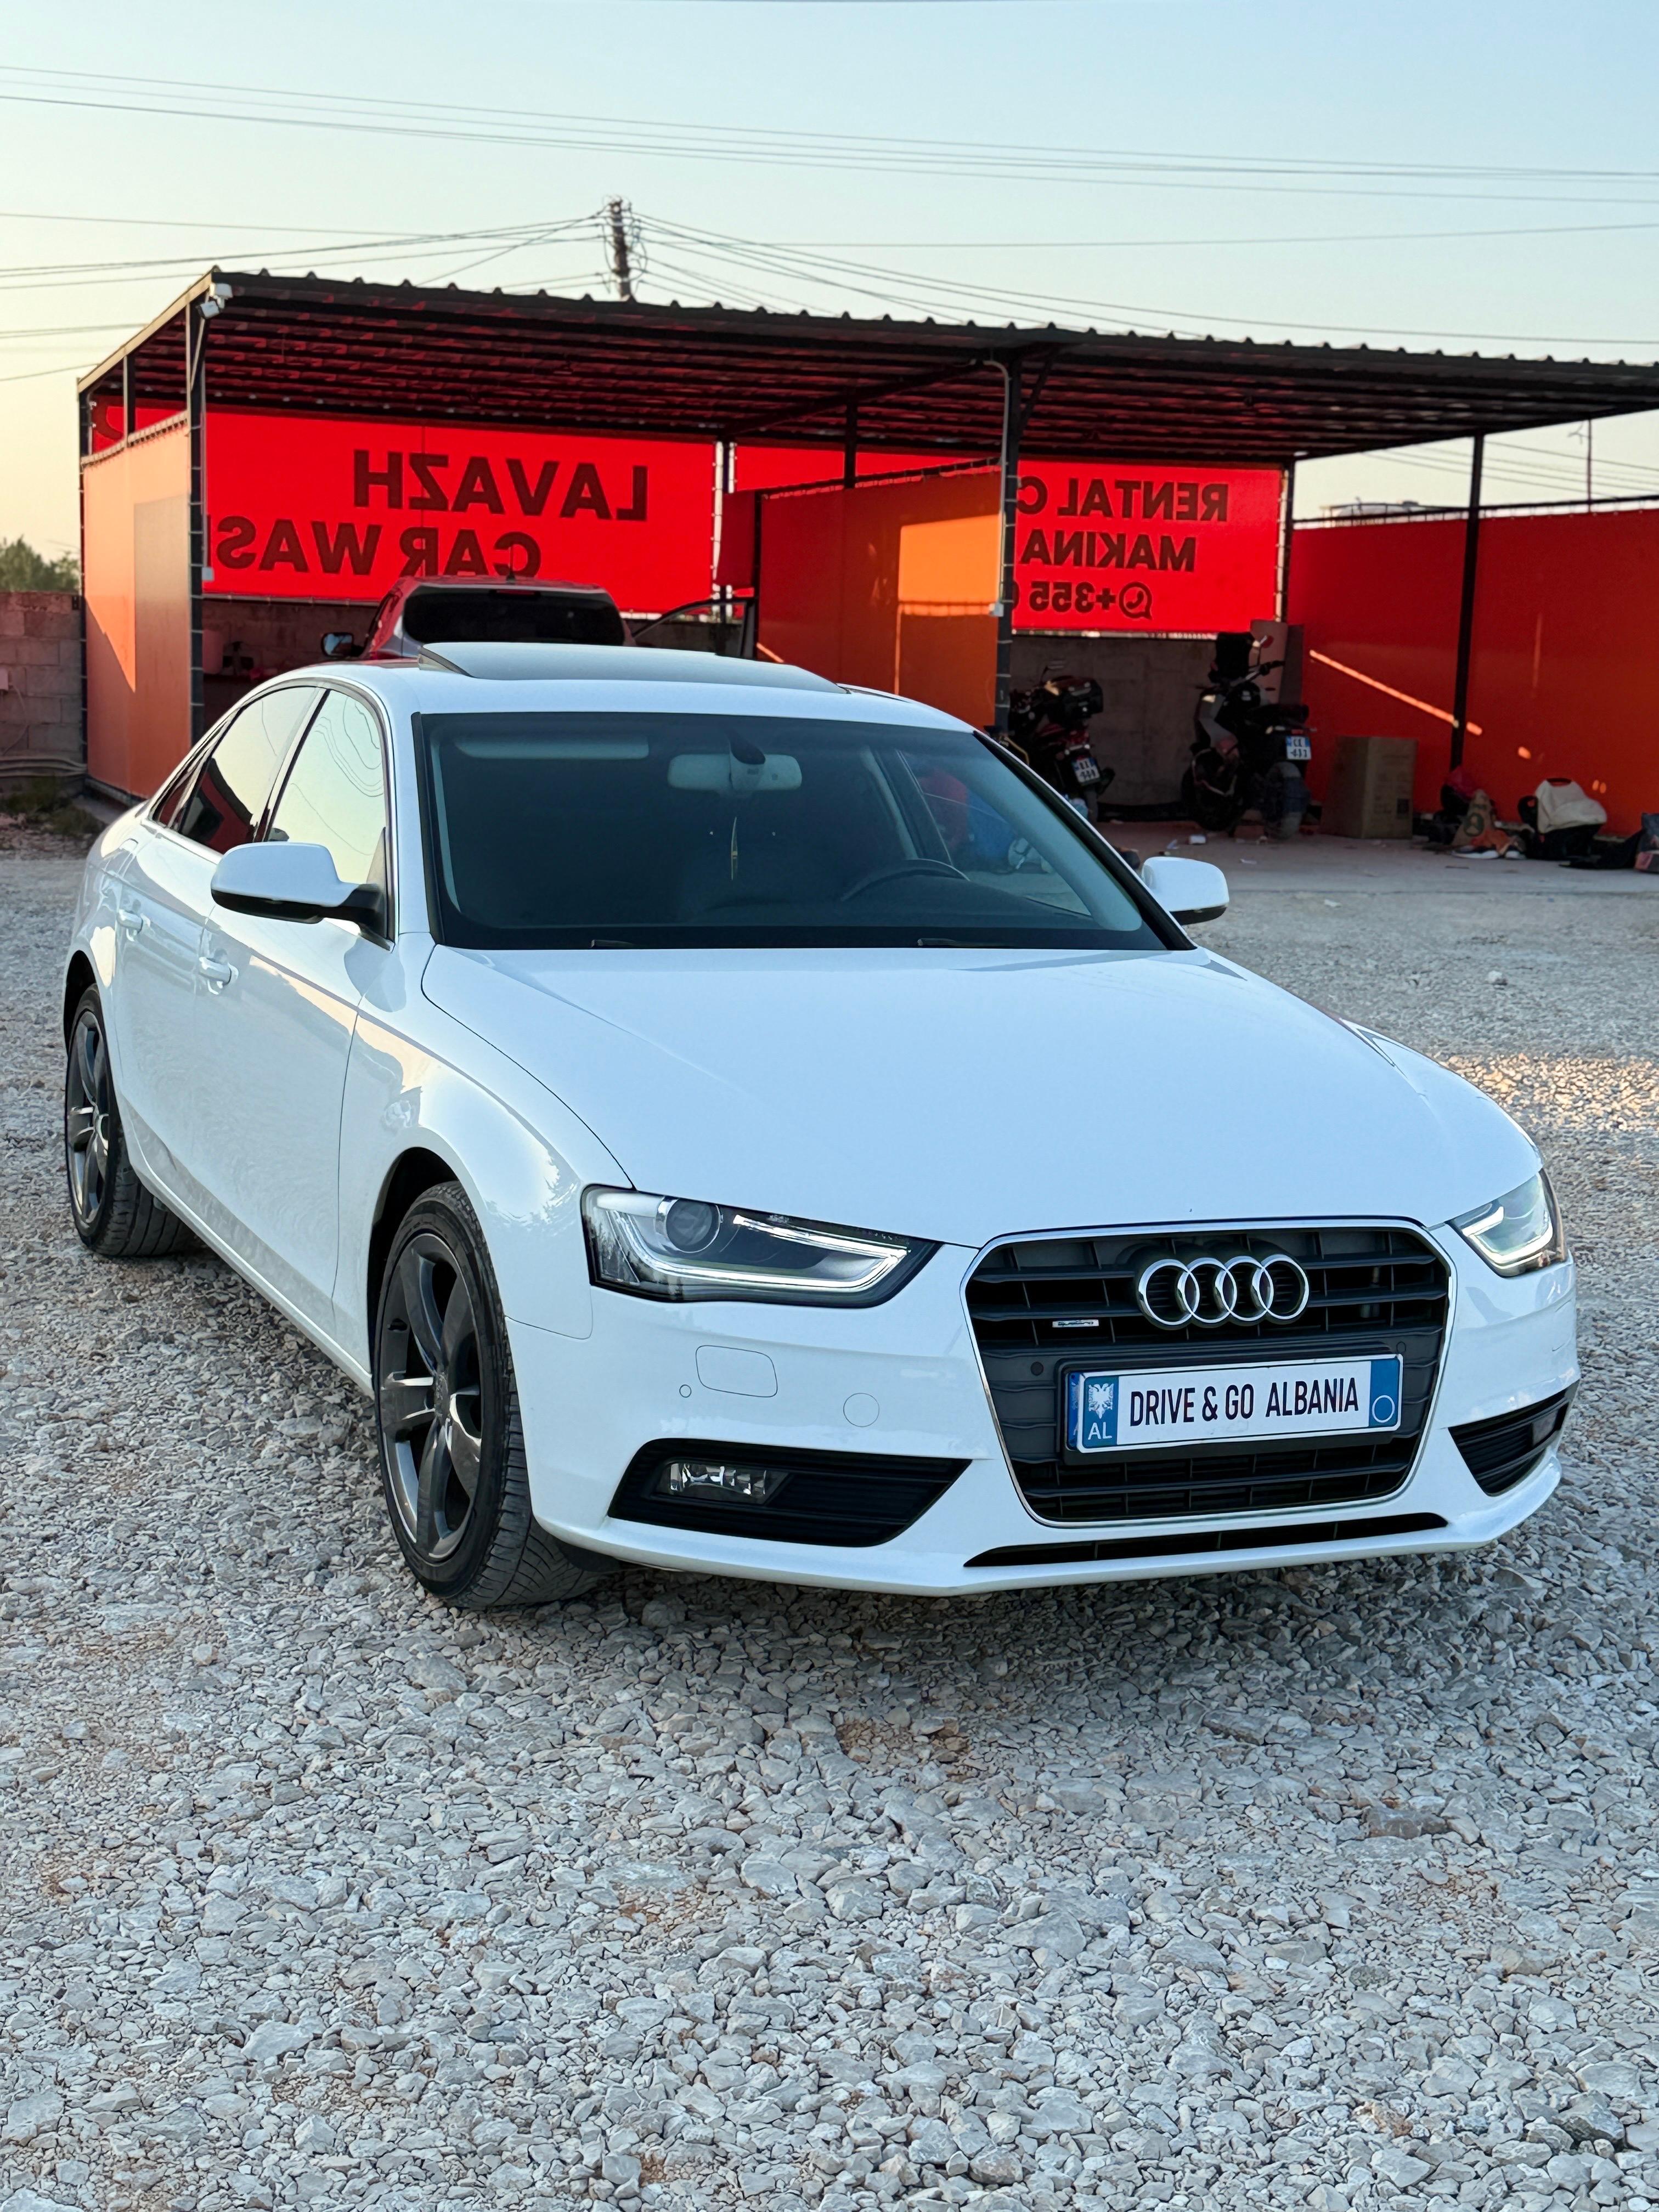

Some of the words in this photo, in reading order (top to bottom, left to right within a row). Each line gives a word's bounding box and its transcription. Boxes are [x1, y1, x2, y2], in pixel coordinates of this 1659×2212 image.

[1130, 1387, 1196, 1427] DRIVE
[1202, 1386, 1218, 1422] &
[1225, 1384, 1255, 1420] GO
[1265, 1377, 1359, 1418] ALBANIA
[1087, 1421, 1113, 1440] AL
